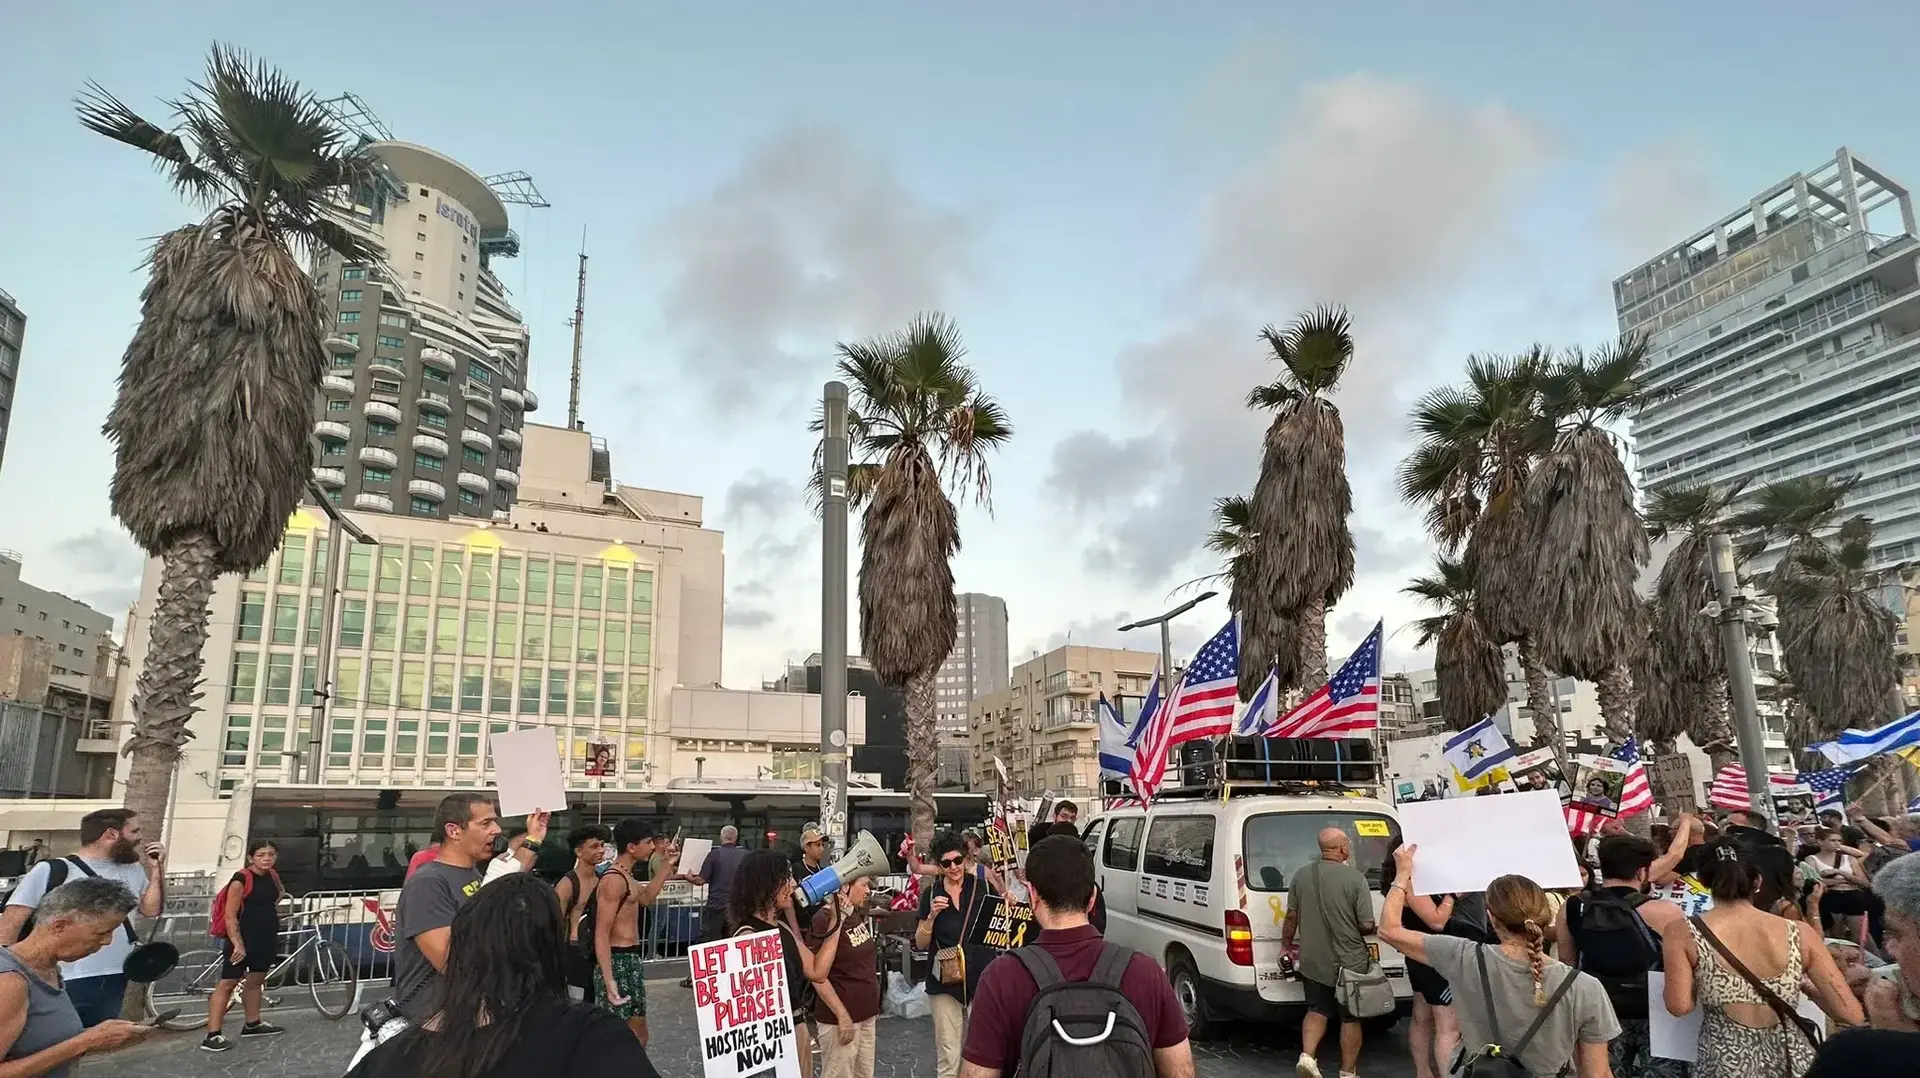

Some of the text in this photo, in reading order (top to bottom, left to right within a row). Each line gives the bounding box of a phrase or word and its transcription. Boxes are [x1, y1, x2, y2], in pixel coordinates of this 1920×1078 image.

[989, 916, 1012, 932] DEAL
[994, 902, 1033, 921] HOSTAGE
[691, 934, 784, 980] LET THERE
[695, 962, 784, 1008] BE LIGHT!
[714, 988, 785, 1032] PLEASE!
[705, 1016, 792, 1060] HOSTAGE DEAL
[737, 1039, 784, 1073] NOW!
